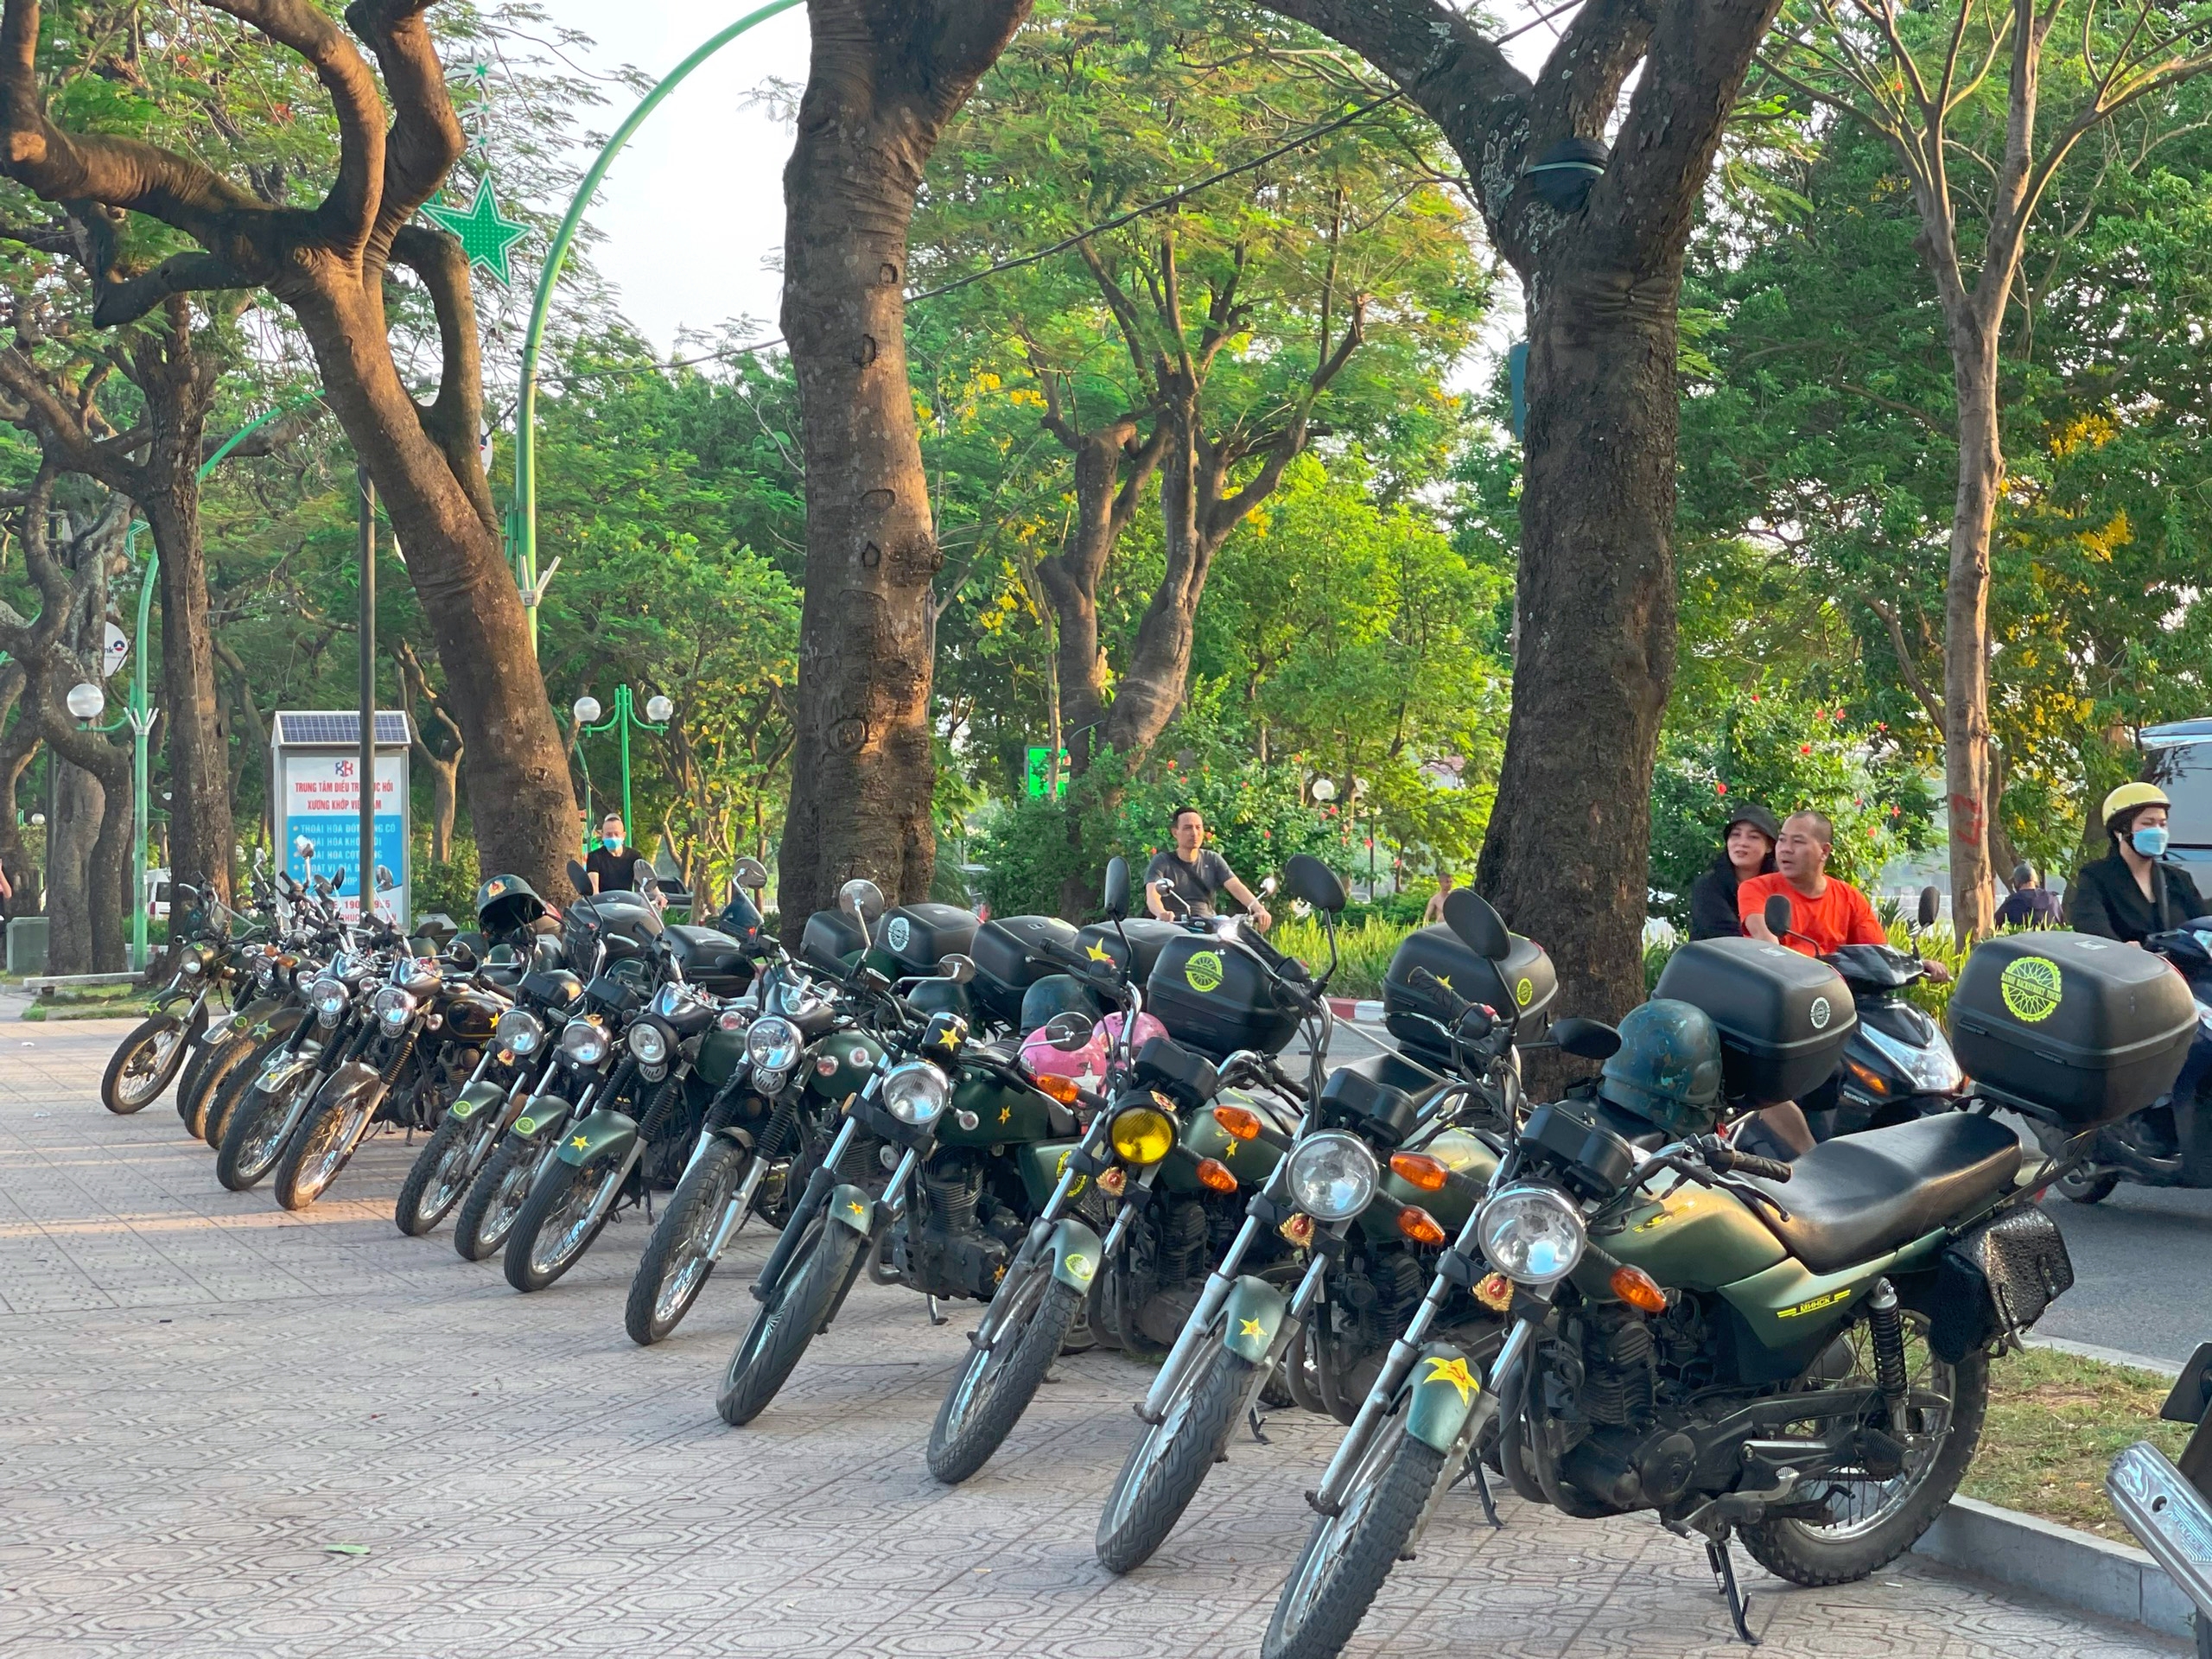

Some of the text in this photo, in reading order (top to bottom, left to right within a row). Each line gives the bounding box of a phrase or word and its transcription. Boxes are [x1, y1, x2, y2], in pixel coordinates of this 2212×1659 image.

[295, 782, 317, 792] TRUNG
[319, 779, 333, 792] TÂM
[1843, 1090, 1870, 1106] HONDA
[2165, 1510, 2202, 1549] AIR BLADE
